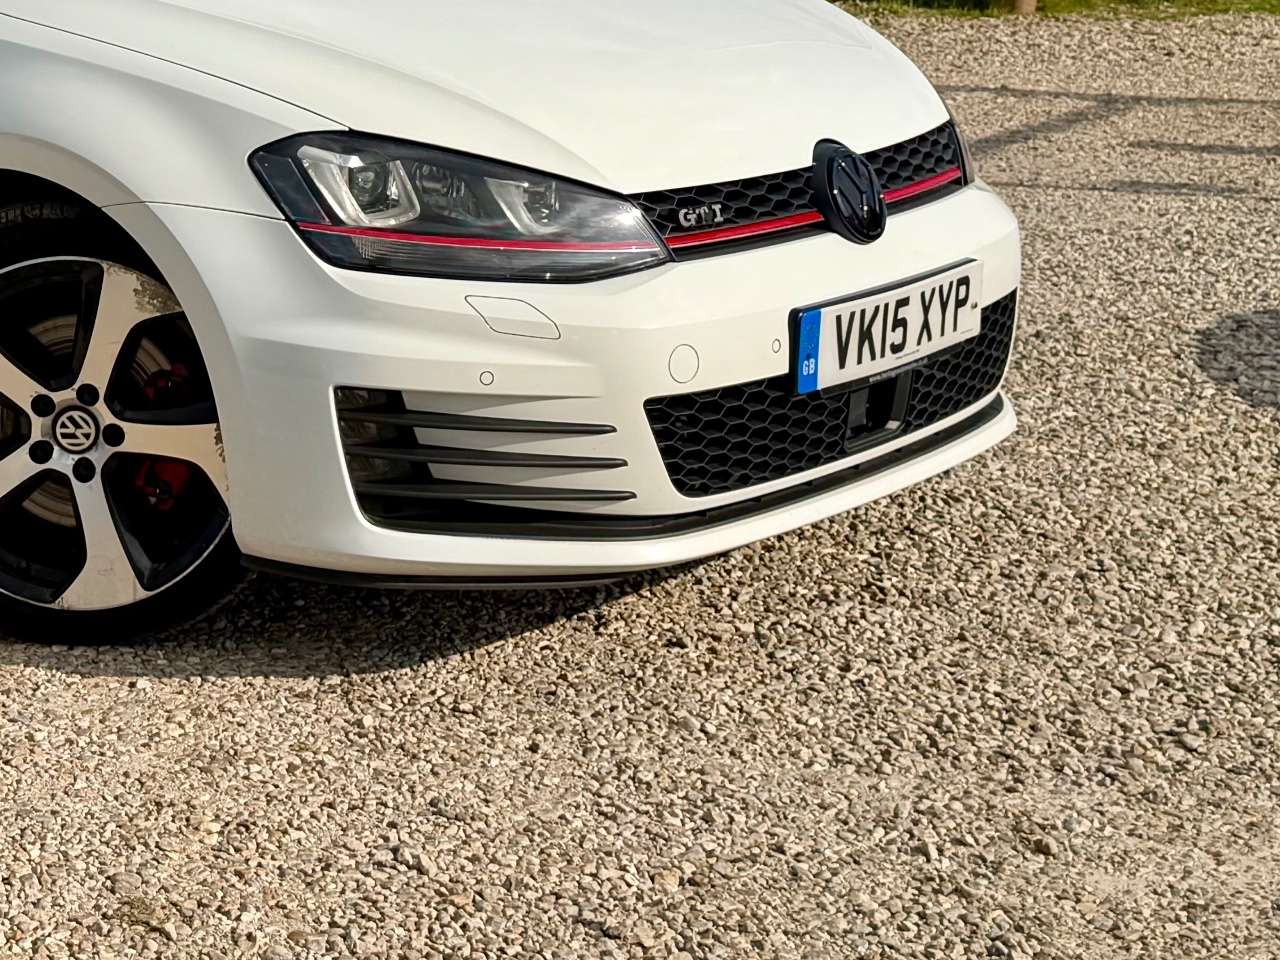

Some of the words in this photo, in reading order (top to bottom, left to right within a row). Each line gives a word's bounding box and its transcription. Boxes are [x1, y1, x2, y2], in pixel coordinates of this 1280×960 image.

[678, 204, 724, 228] GTI
[835, 295, 910, 371] VK15
[916, 274, 971, 347] XYP
[802, 358, 816, 376] GB
